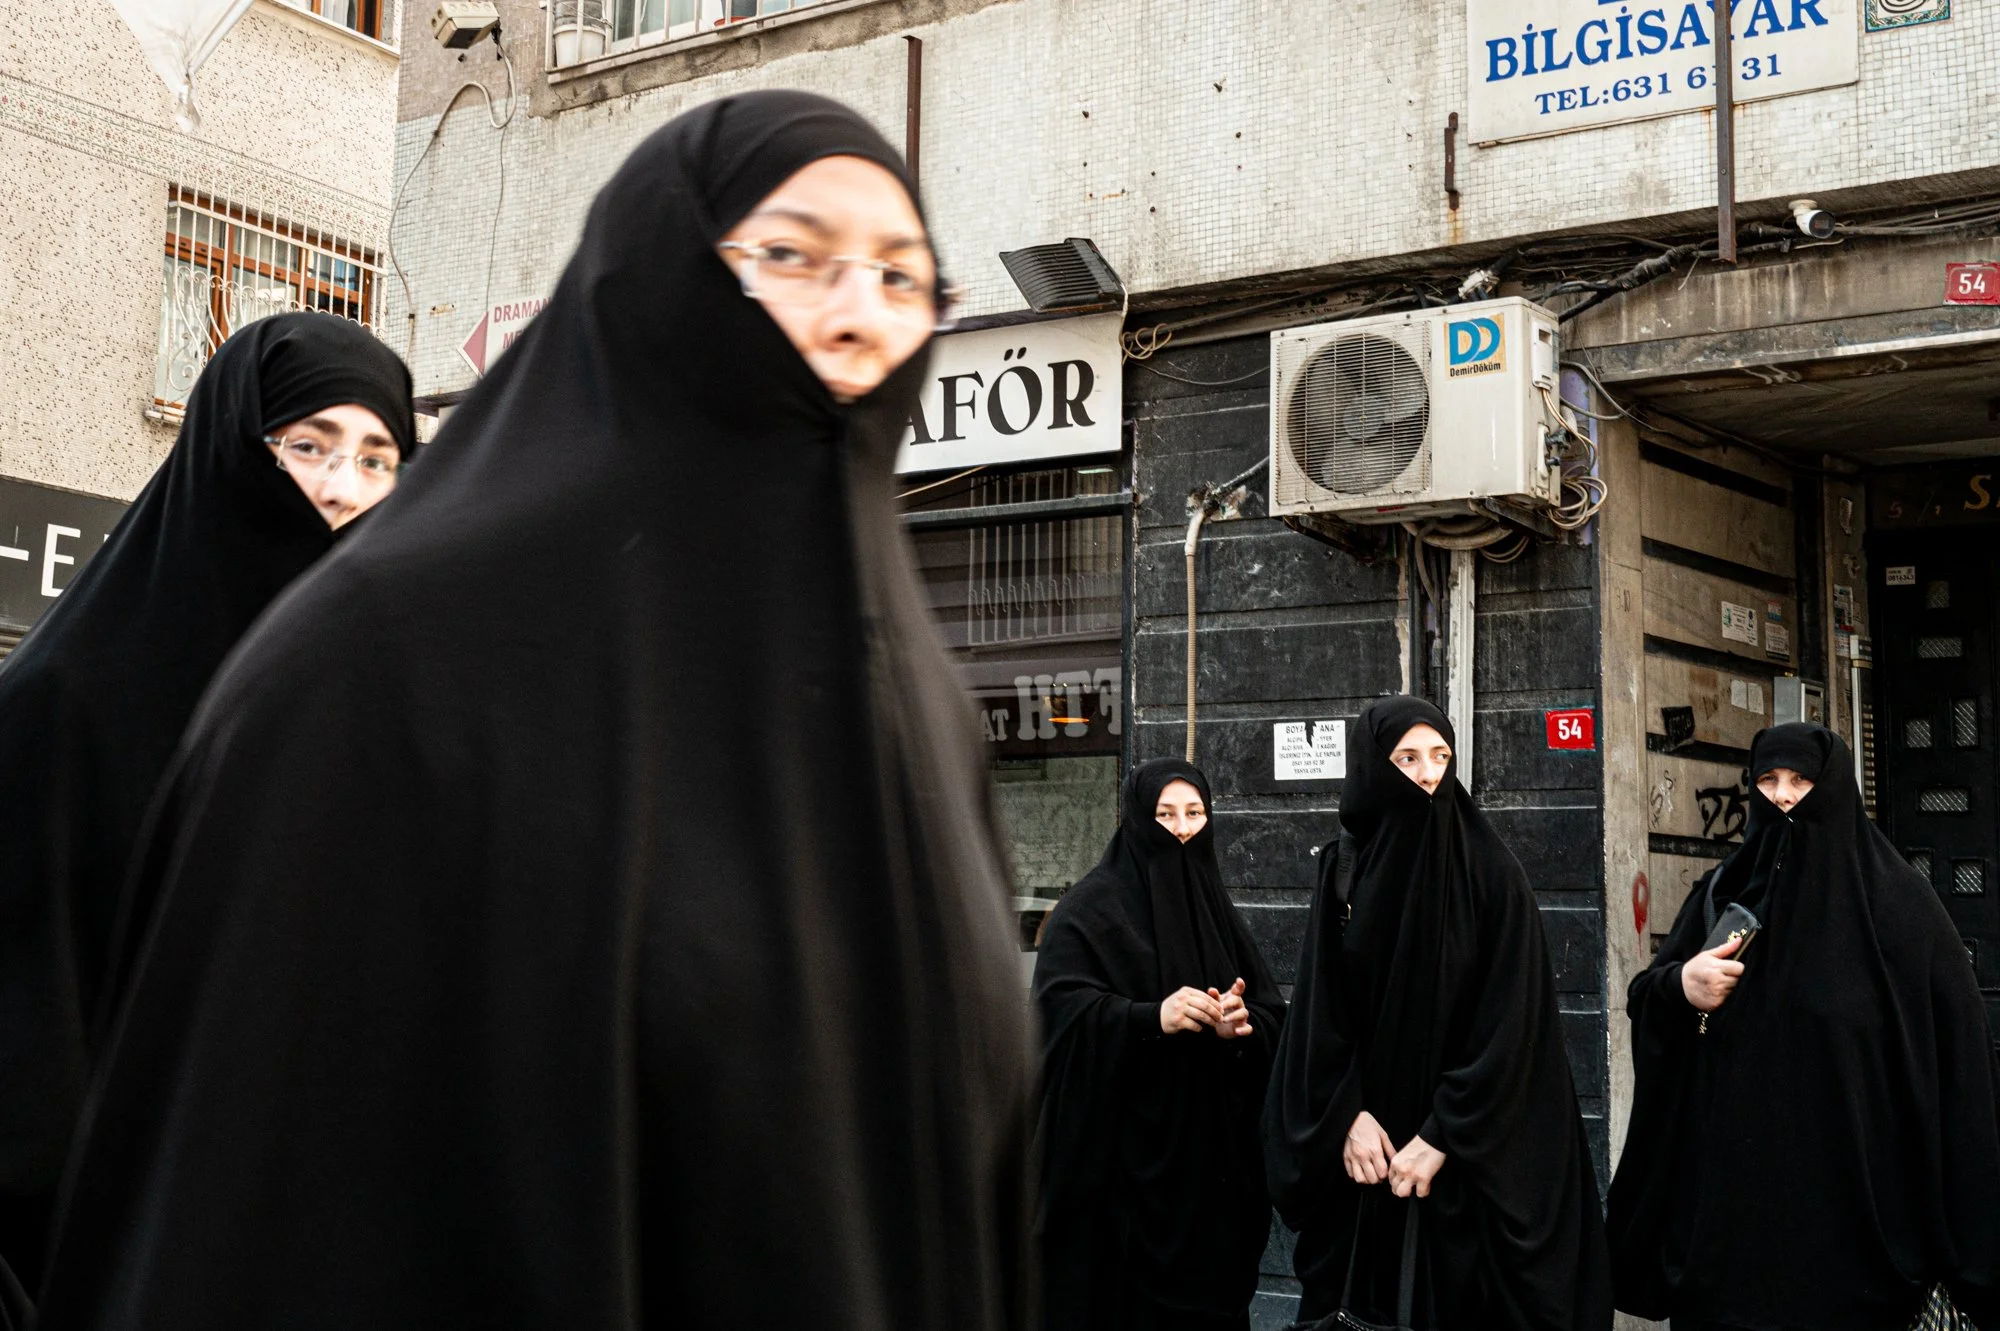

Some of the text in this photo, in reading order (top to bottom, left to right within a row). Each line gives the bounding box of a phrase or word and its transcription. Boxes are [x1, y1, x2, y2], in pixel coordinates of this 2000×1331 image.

[1535, 54, 1782, 115] TEL:631 6 31
[1958, 272, 1986, 295] 54
[1449, 362, 1501, 377] DemirDöküm
[1558, 718, 1582, 741] 54
